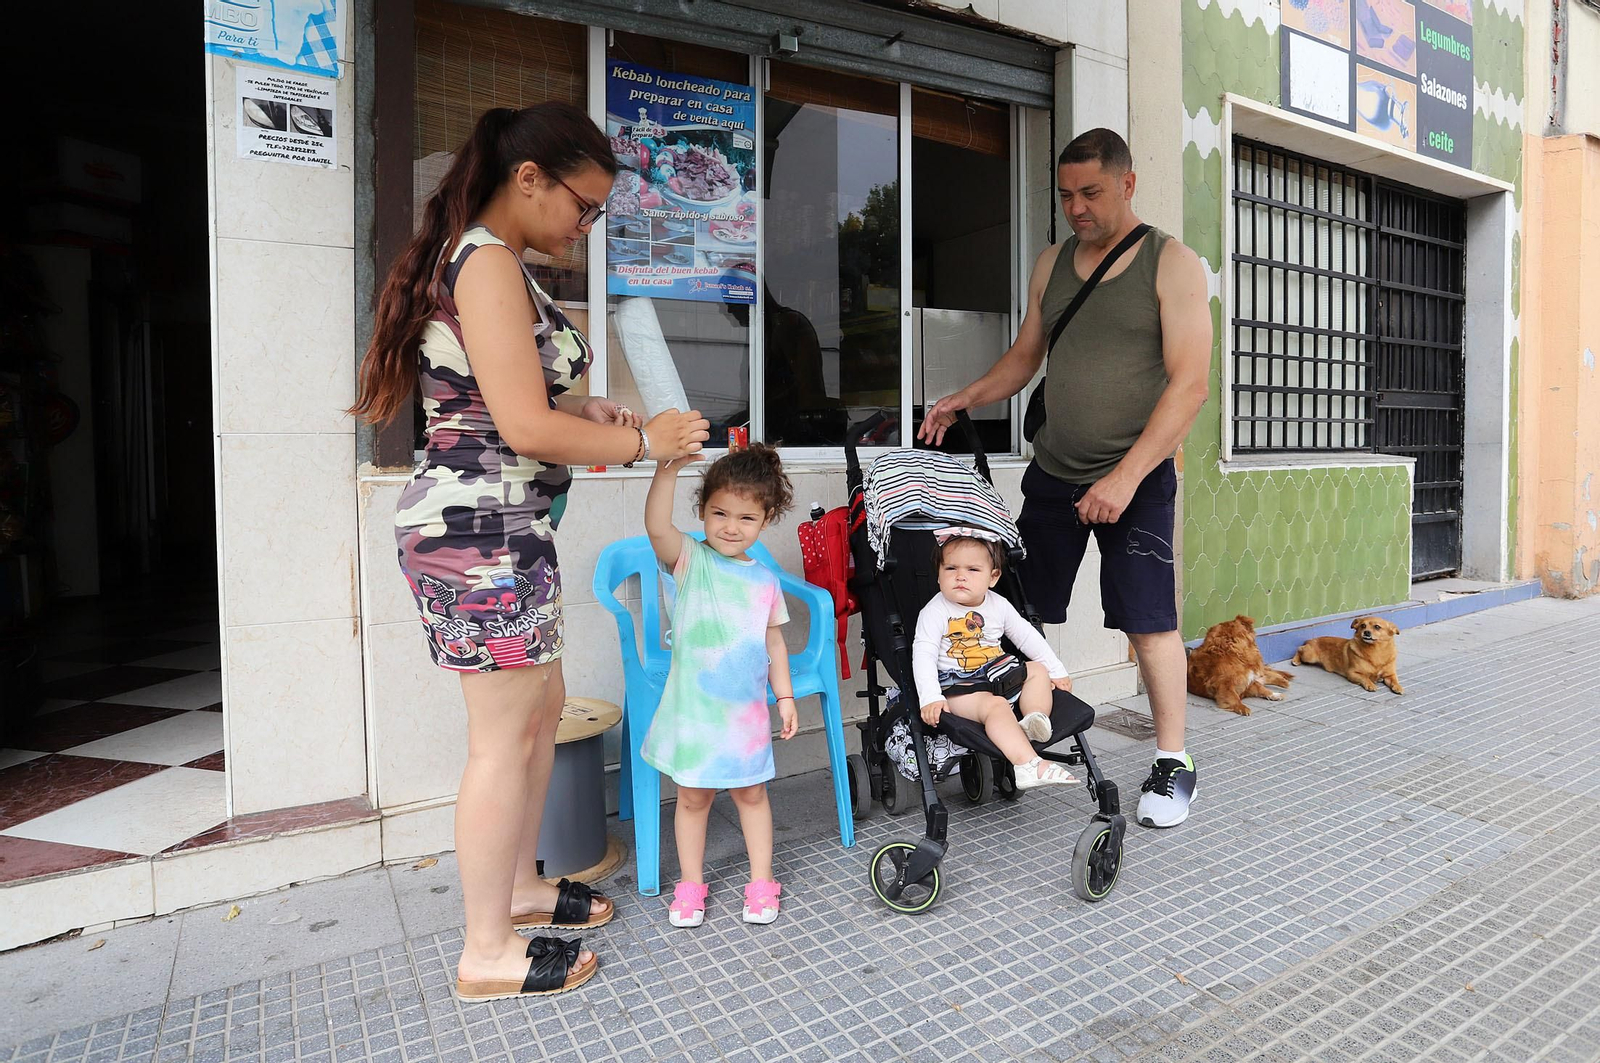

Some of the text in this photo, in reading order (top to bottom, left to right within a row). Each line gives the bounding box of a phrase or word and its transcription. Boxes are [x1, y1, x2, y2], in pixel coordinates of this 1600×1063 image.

[217, 30, 260, 47] Para ti
[1420, 20, 1471, 61] Legumbres
[612, 66, 751, 102] Kebab loncheado para
[1420, 72, 1468, 110] Salazones
[628, 89, 734, 114] preparar en casa
[673, 111, 745, 131] de venta aquí
[258, 133, 288, 143] PRECIOS
[289, 138, 309, 146] DESDE
[249, 149, 333, 165] PREGUNTAR POR DANIEL
[642, 209, 745, 222] Sano, rápido y sabroso
[617, 266, 719, 277] Disfruta del buen kebab
[641, 278, 651, 286] tu
